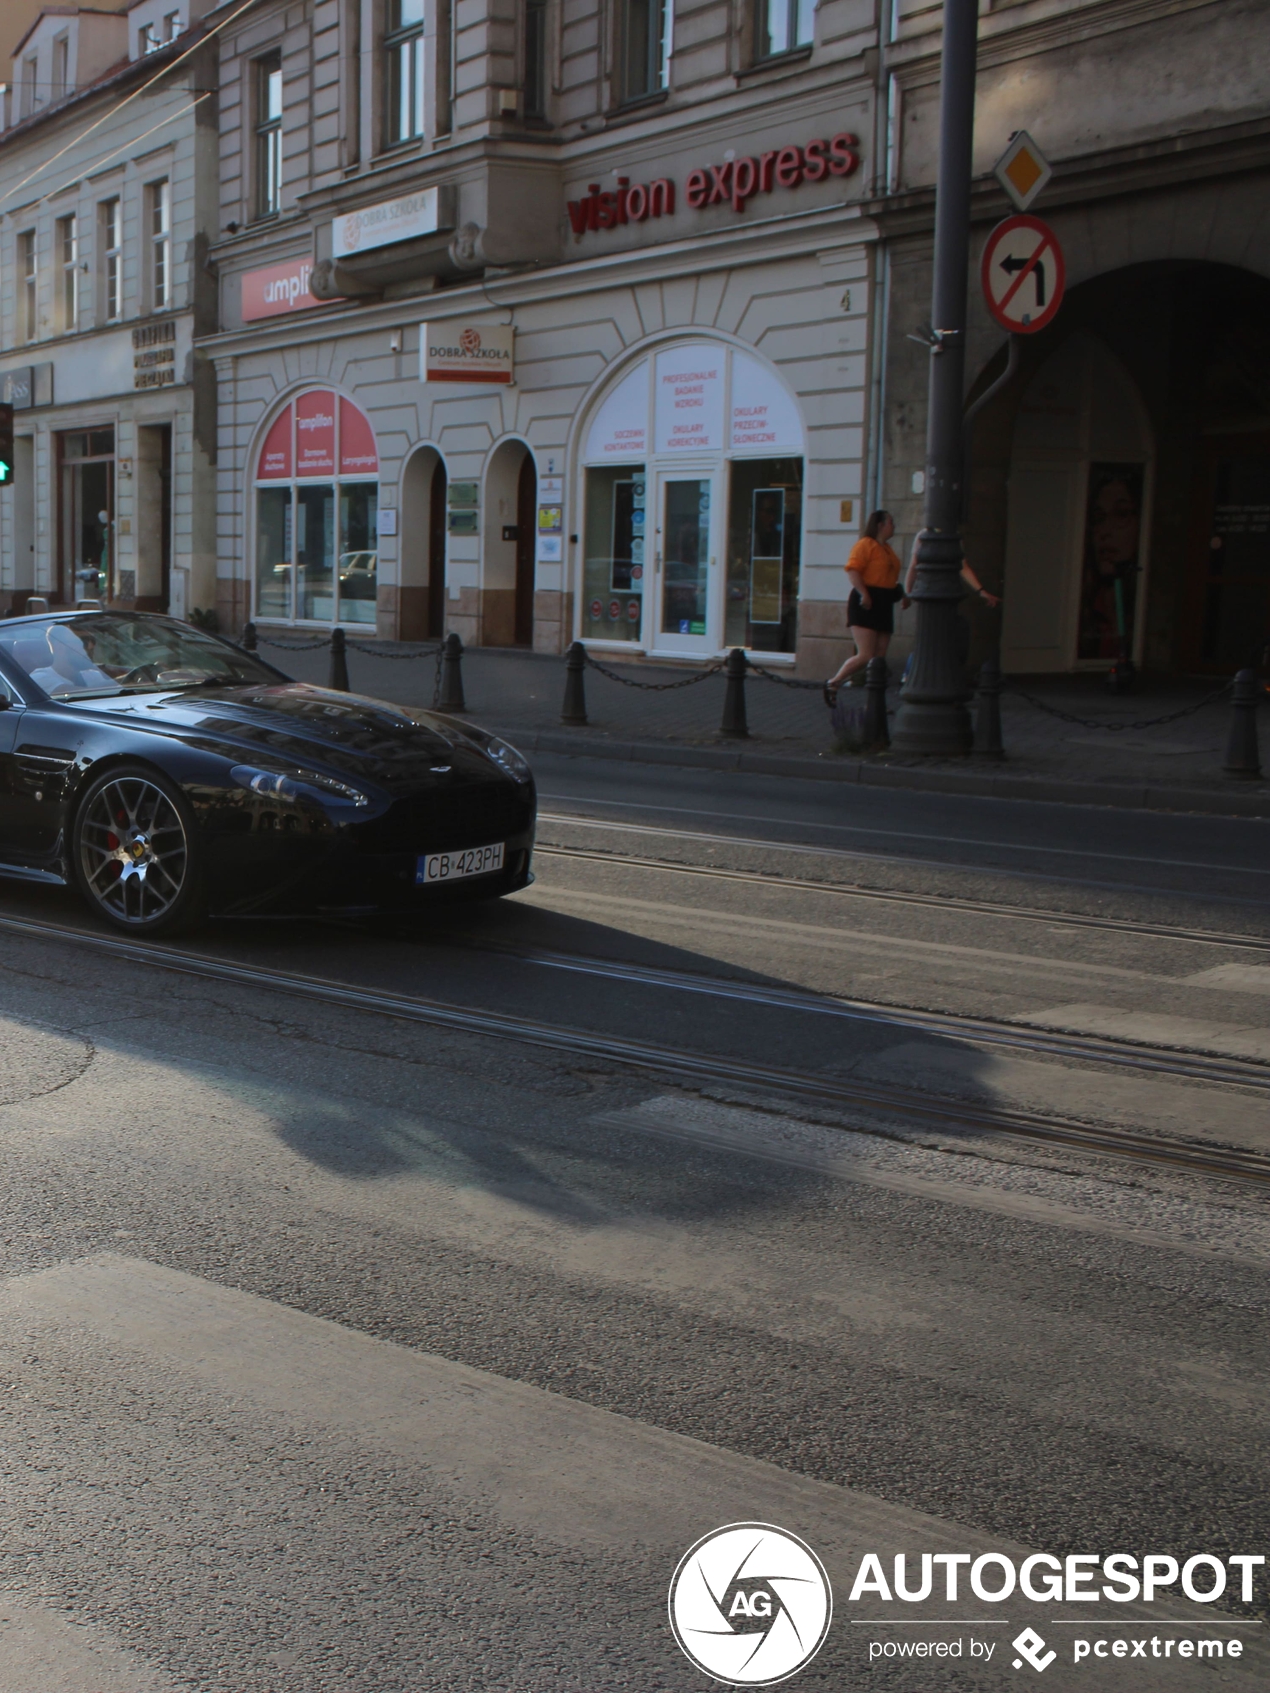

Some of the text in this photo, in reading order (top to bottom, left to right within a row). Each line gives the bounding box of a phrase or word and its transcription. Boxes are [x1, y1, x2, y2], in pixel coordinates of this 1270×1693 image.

[567, 132, 860, 235] vision express
[355, 208, 387, 229] DOBRA
[389, 196, 427, 220] SZKOŁA
[840, 289, 851, 312] 4
[430, 347, 510, 359] DOBRA SZKOŁA
[662, 370, 718, 384] PROFESJONALNE
[674, 385, 704, 396] BADANIE
[674, 398, 704, 409] WZROKU
[734, 406, 768, 417] OKULARY
[299, 413, 333, 431] amplifon
[734, 419, 769, 430] PRZECIW-
[614, 429, 645, 440] SOCZEWKI
[673, 423, 704, 435] OKULARY
[667, 436, 710, 447] KOREKCYJNE
[733, 432, 776, 444] SŁONECZNE
[604, 441, 645, 452] KONTAKTOWE
[427, 855, 450, 879] CB
[456, 845, 502, 874] 423PH
